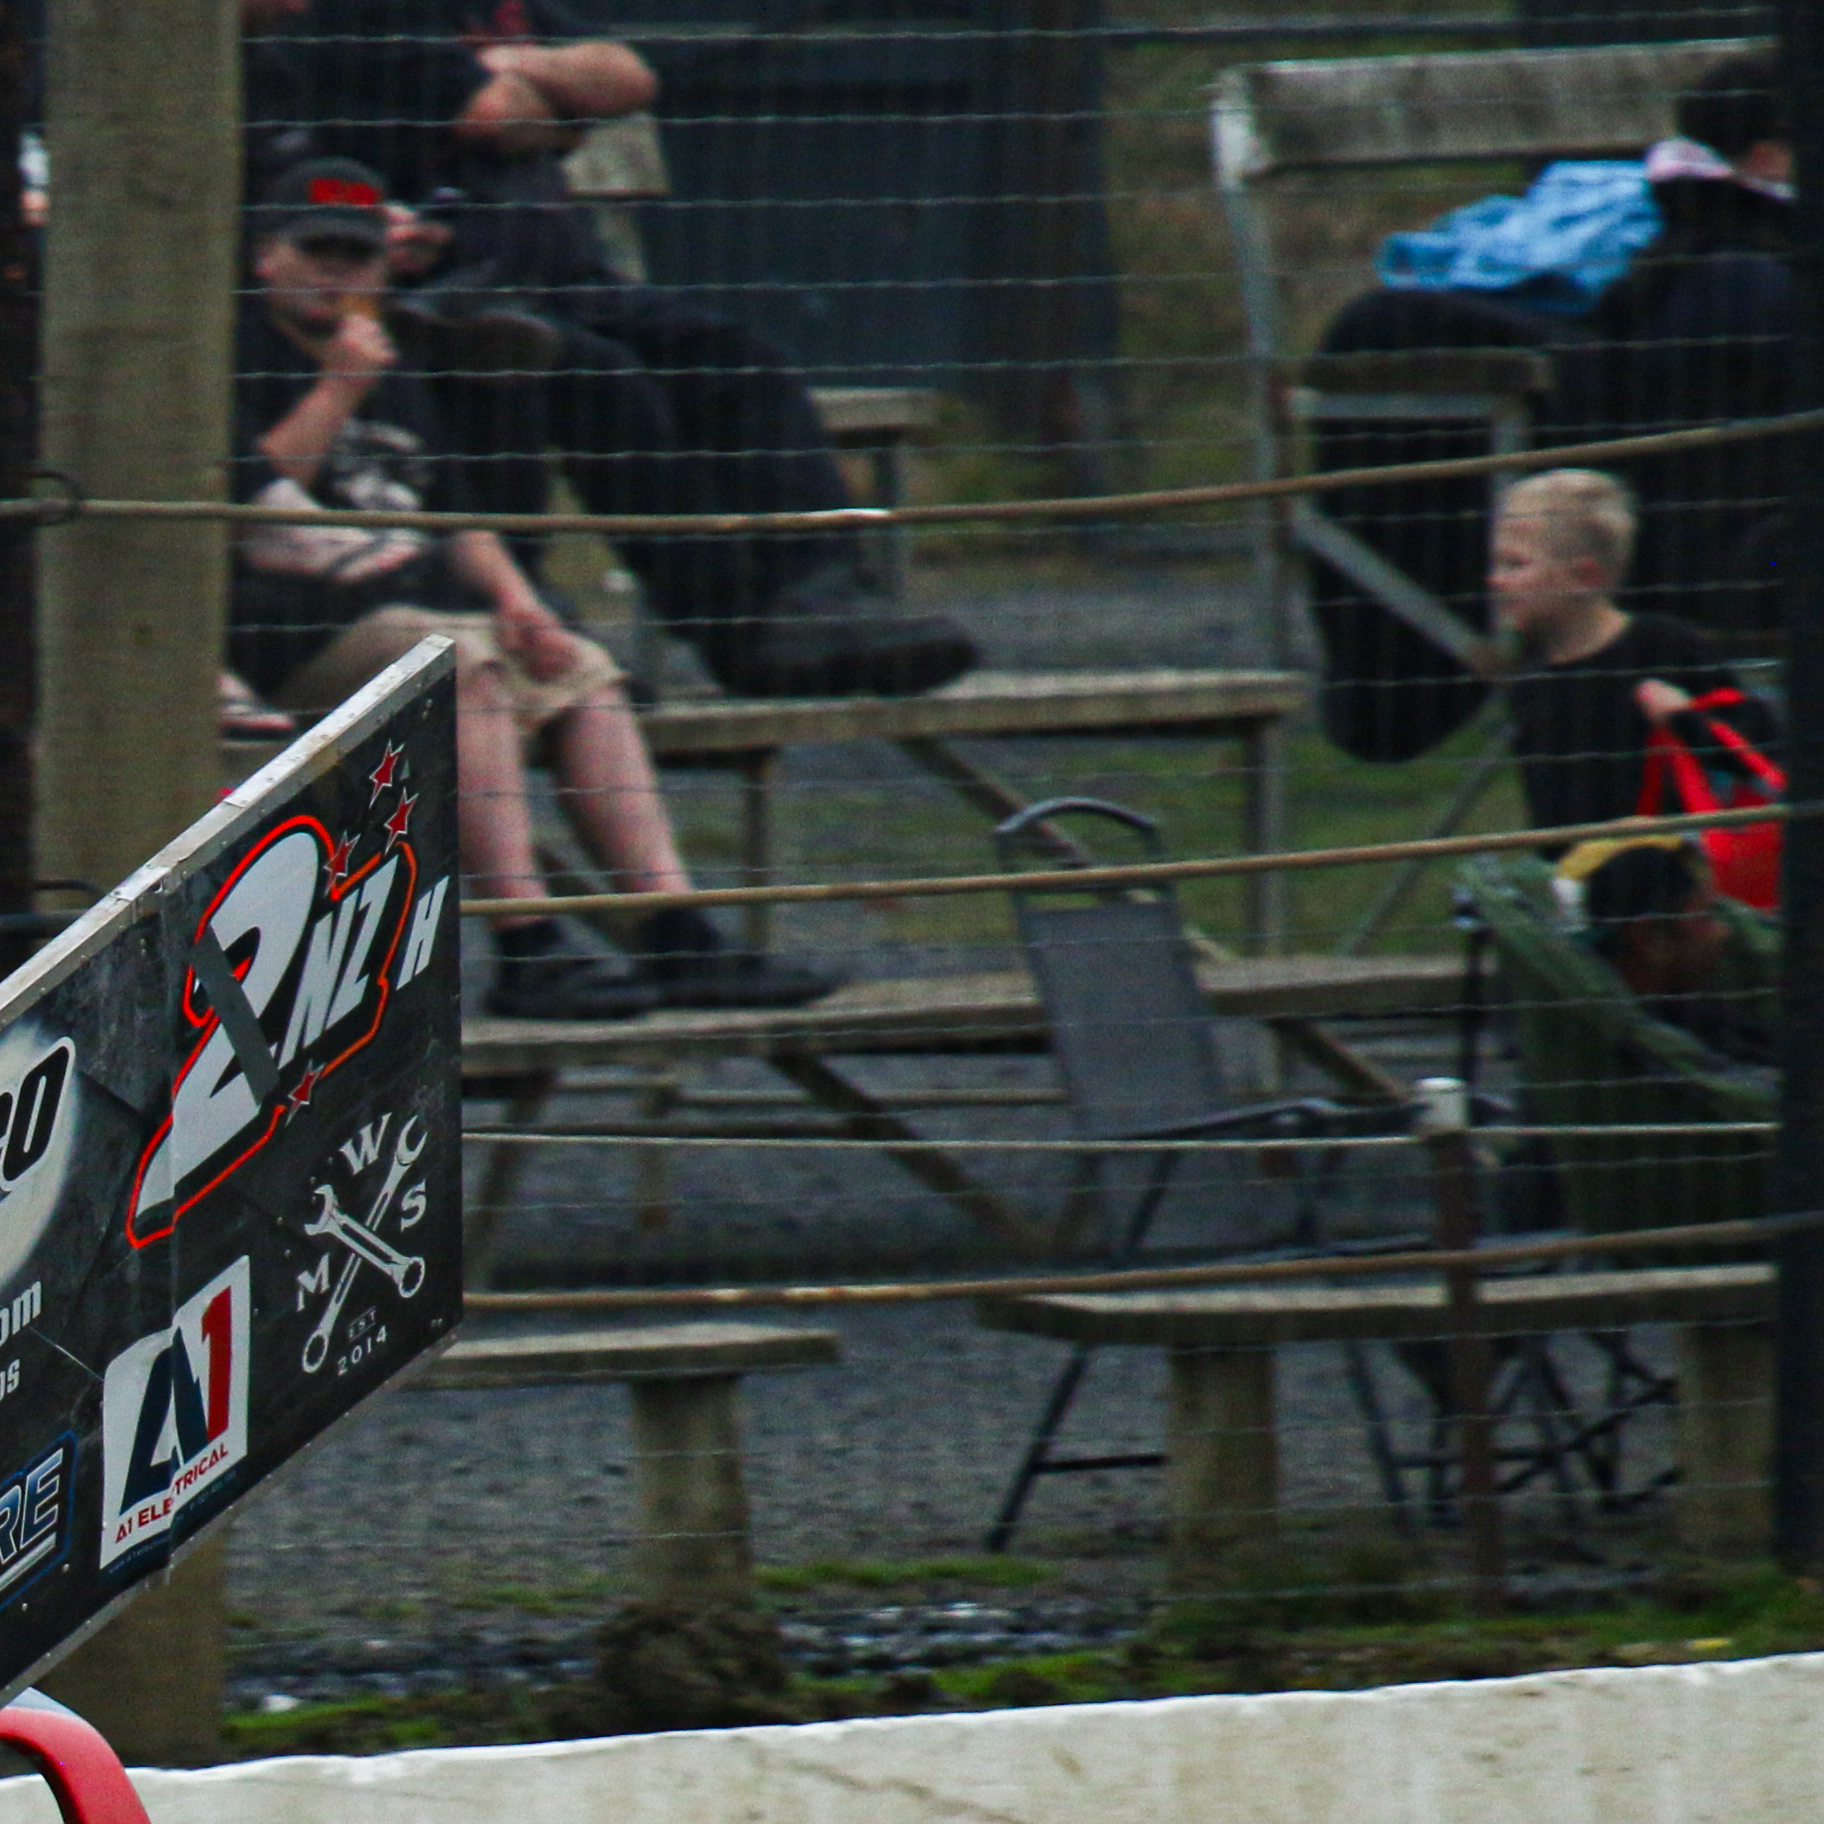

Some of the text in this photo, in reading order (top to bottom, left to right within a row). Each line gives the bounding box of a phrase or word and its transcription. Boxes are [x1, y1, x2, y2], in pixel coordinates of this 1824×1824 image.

[118, 1284, 232, 1517] A1
[337, 1325, 388, 1376] 2014
[115, 1516, 133, 1545] A1
[137, 1442, 230, 1530] ELETRICAL
